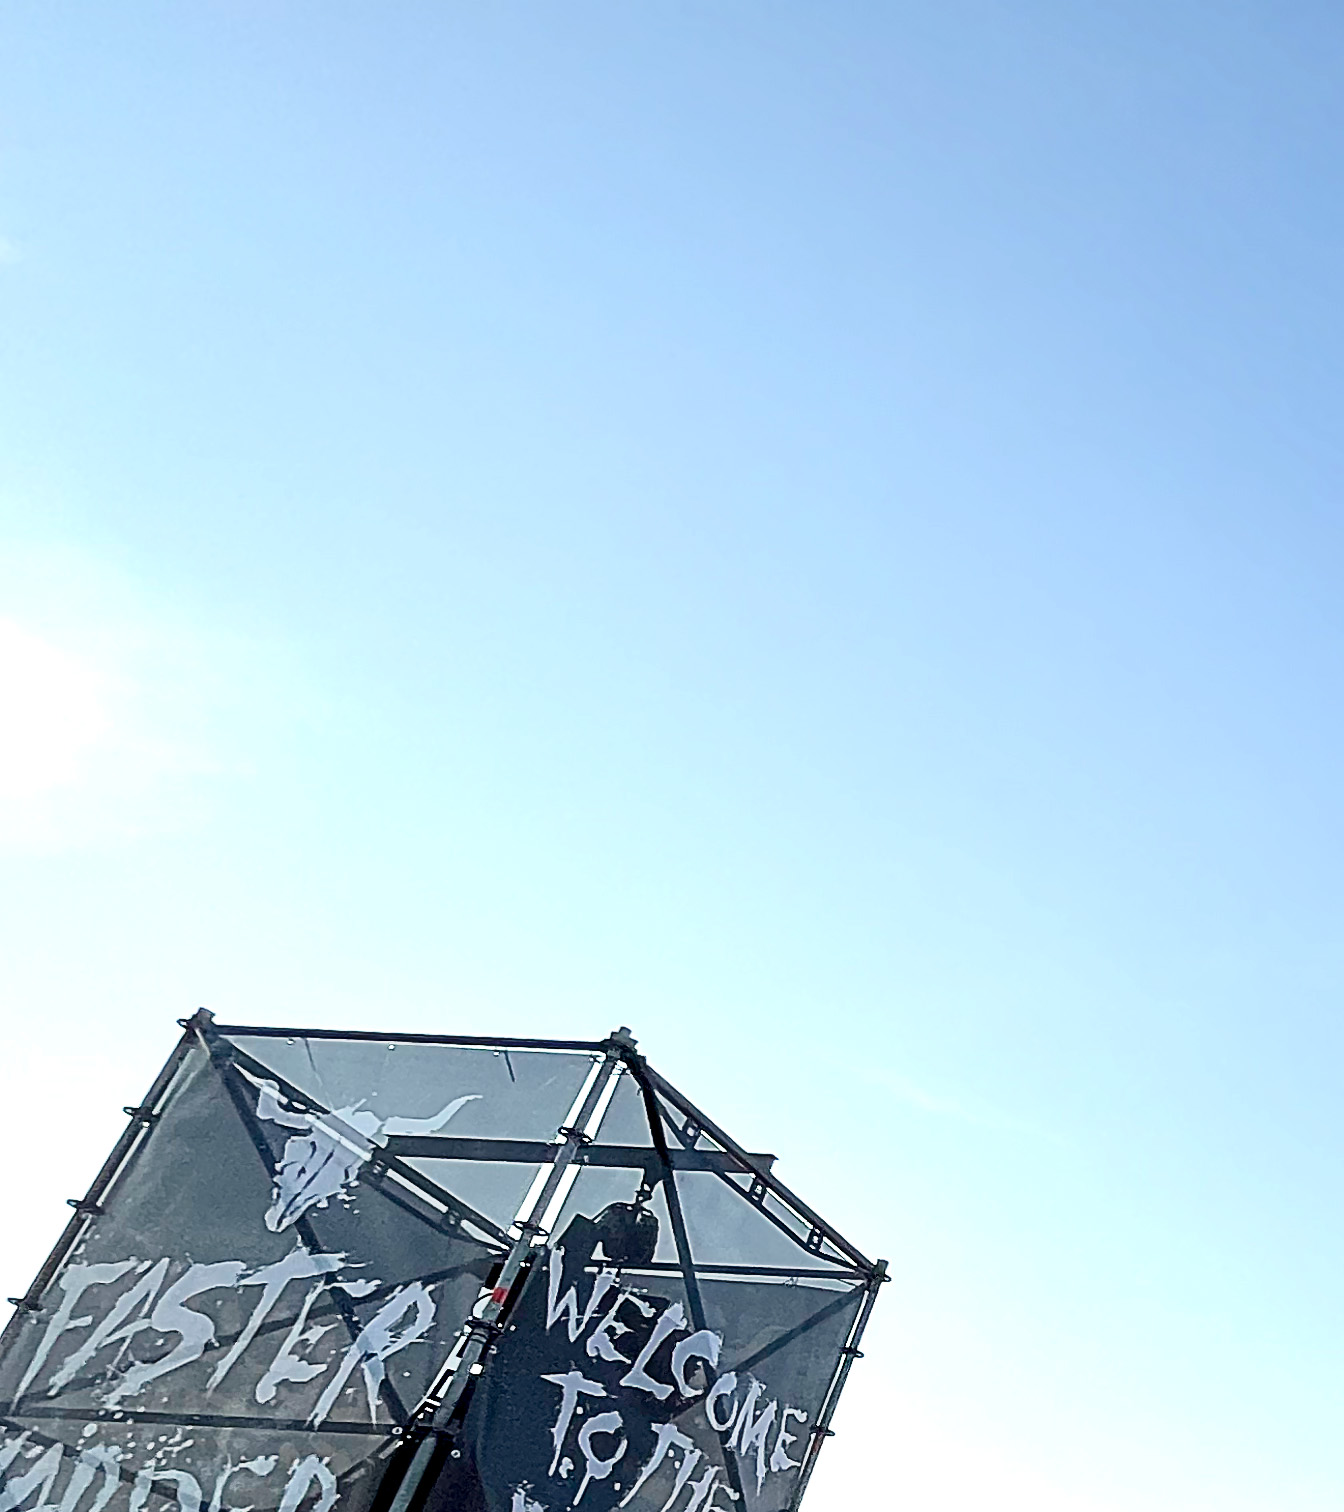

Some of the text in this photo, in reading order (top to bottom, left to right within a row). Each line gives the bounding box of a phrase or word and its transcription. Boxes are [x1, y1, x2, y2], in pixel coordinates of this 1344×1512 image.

[12, 1246, 438, 1430] FASTER
[546, 1246, 807, 1490] WELCOME
[540, 1371, 628, 1505] TO
